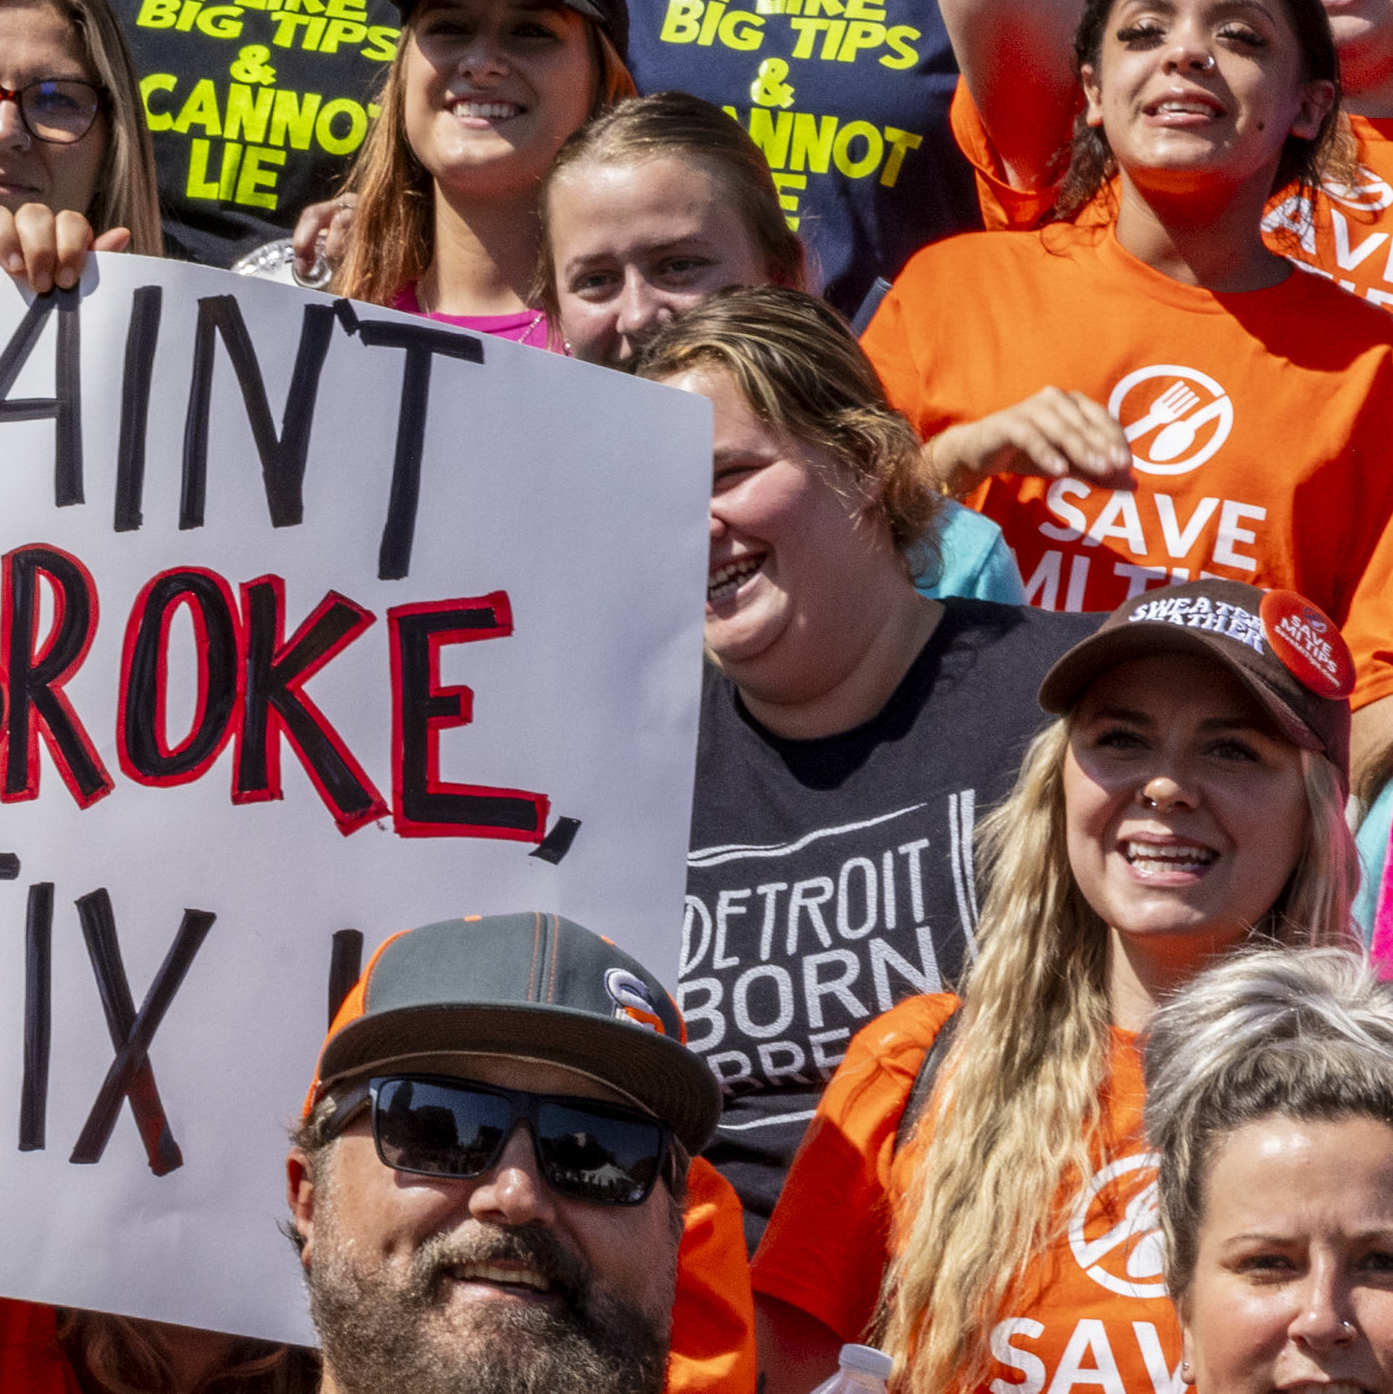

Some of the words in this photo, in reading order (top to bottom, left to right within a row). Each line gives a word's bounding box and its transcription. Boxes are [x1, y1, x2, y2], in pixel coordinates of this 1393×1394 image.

[270, 10, 403, 62] TIPS
[789, 16, 922, 71] TIPS
[229, 44, 277, 87] &
[749, 57, 796, 109] &
[138, 73, 383, 156] CANNO
[185, 137, 288, 212] LIE
[1037, 477, 1268, 573] SAVE
[1280, 617, 1302, 642] MI
[1304, 636, 1338, 674] TIPS
[1291, 614, 1333, 658] SAVE
[677, 837, 931, 980] DETROIT
[676, 925, 944, 1054] BORN
